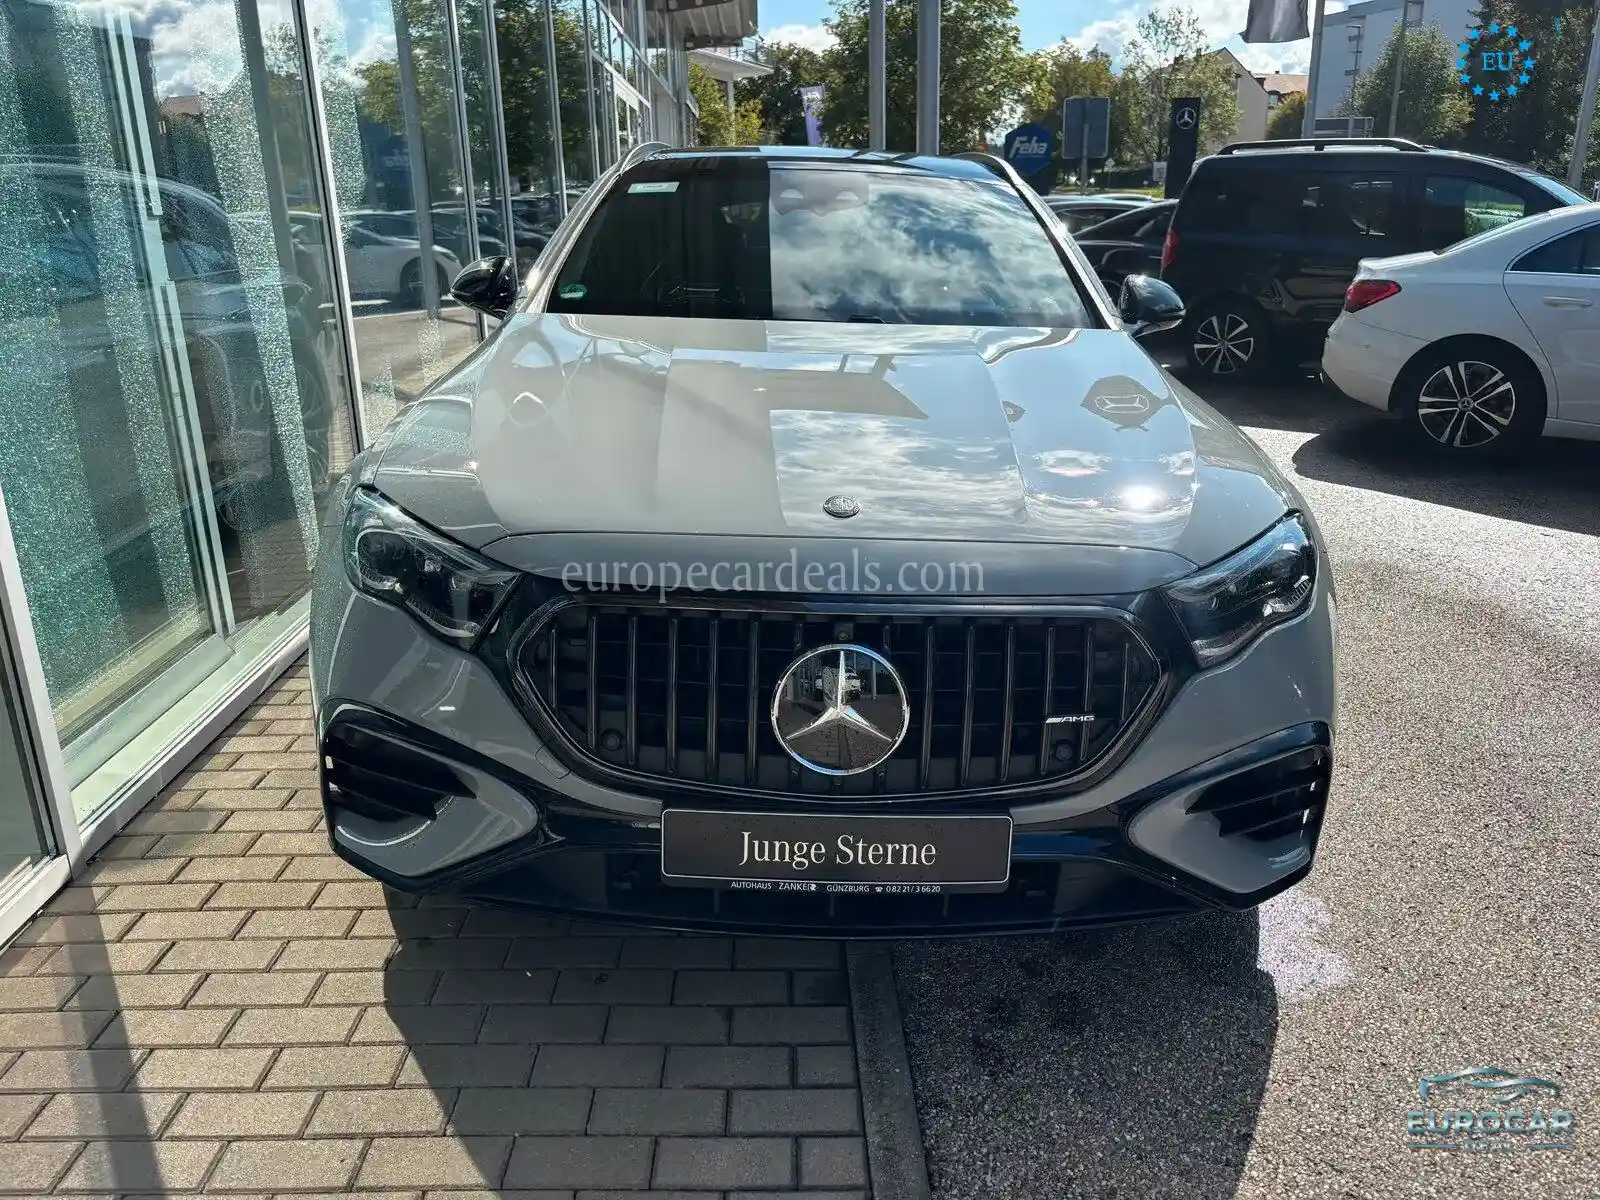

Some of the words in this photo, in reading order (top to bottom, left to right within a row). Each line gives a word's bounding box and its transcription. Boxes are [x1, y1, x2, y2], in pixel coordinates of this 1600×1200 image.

[1009, 136, 1048, 159] Feha
[739, 831, 826, 869] Junge
[836, 835, 937, 865] Sterne
[731, 881, 772, 890] AUTOHAUS
[826, 883, 870, 893] GÜNZBURG
